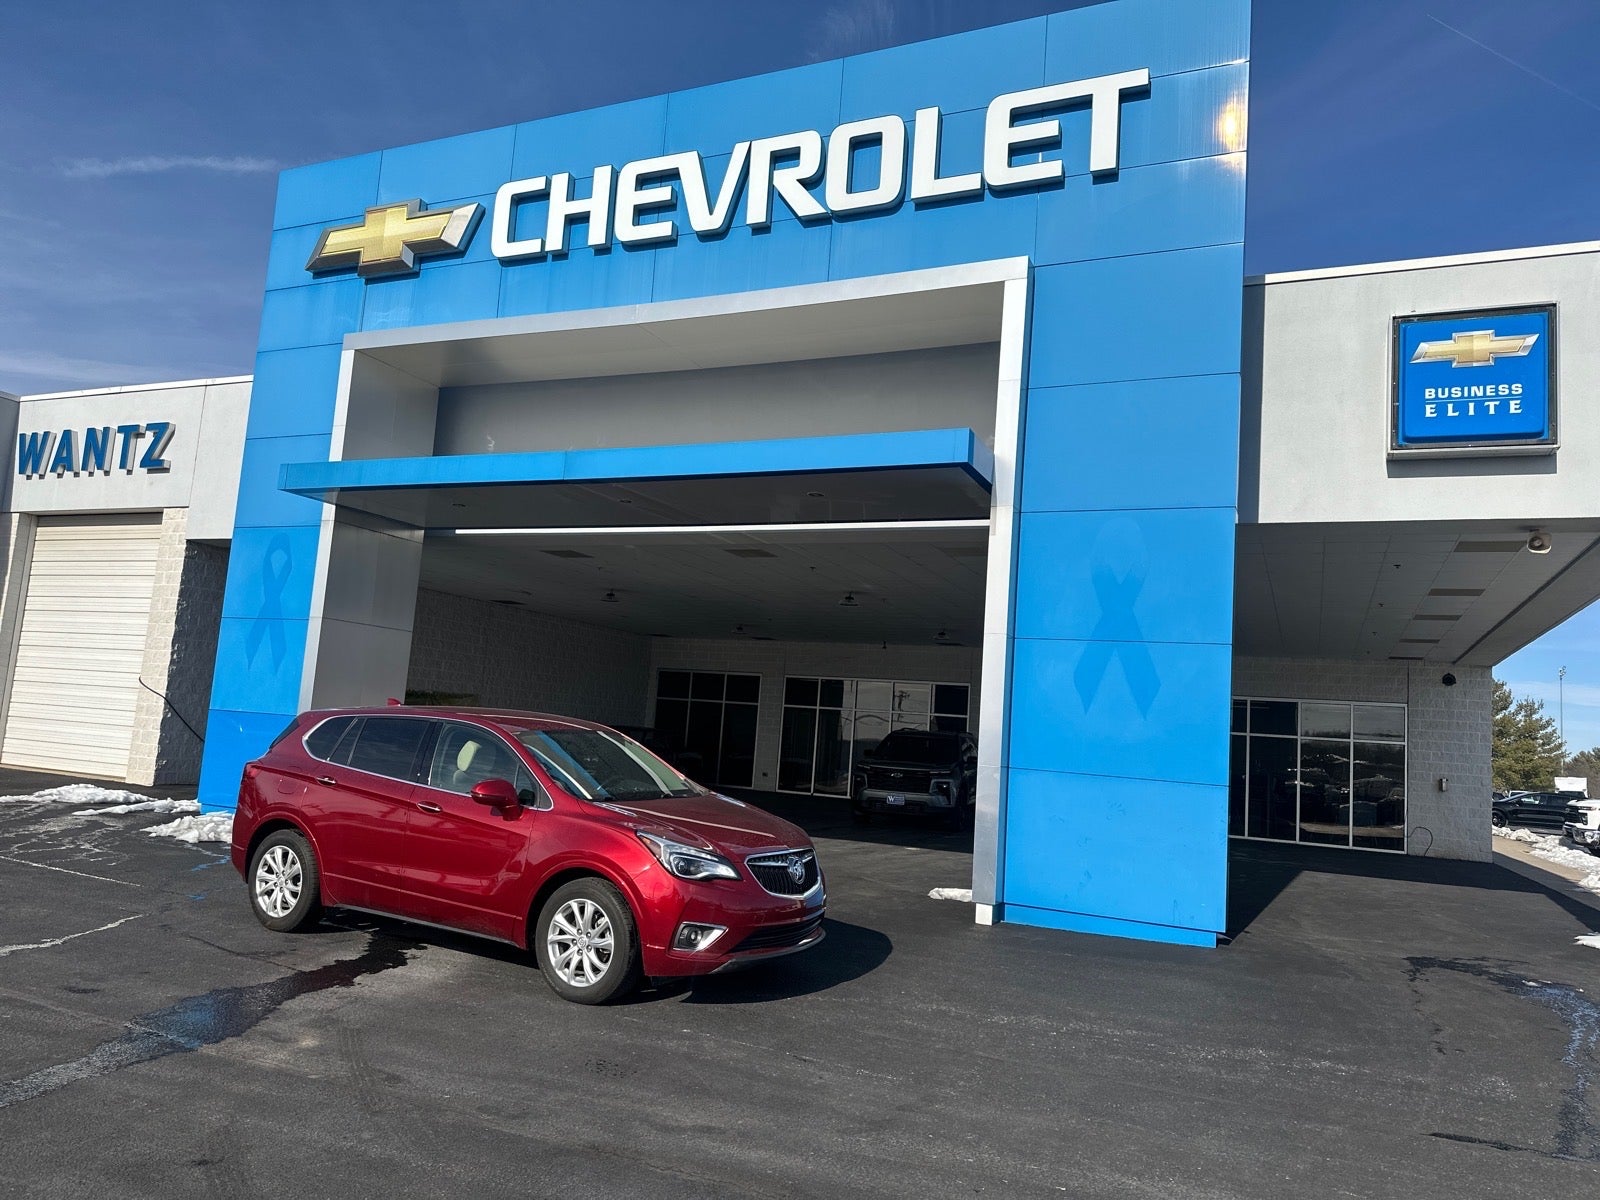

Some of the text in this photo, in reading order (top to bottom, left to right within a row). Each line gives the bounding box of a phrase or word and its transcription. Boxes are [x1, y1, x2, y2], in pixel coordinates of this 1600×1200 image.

[490, 68, 1150, 260] CHEVROLET
[1424, 383, 1523, 398] BUSINESS
[1424, 400, 1523, 417] ELITE
[18, 421, 176, 478] WANTZ
